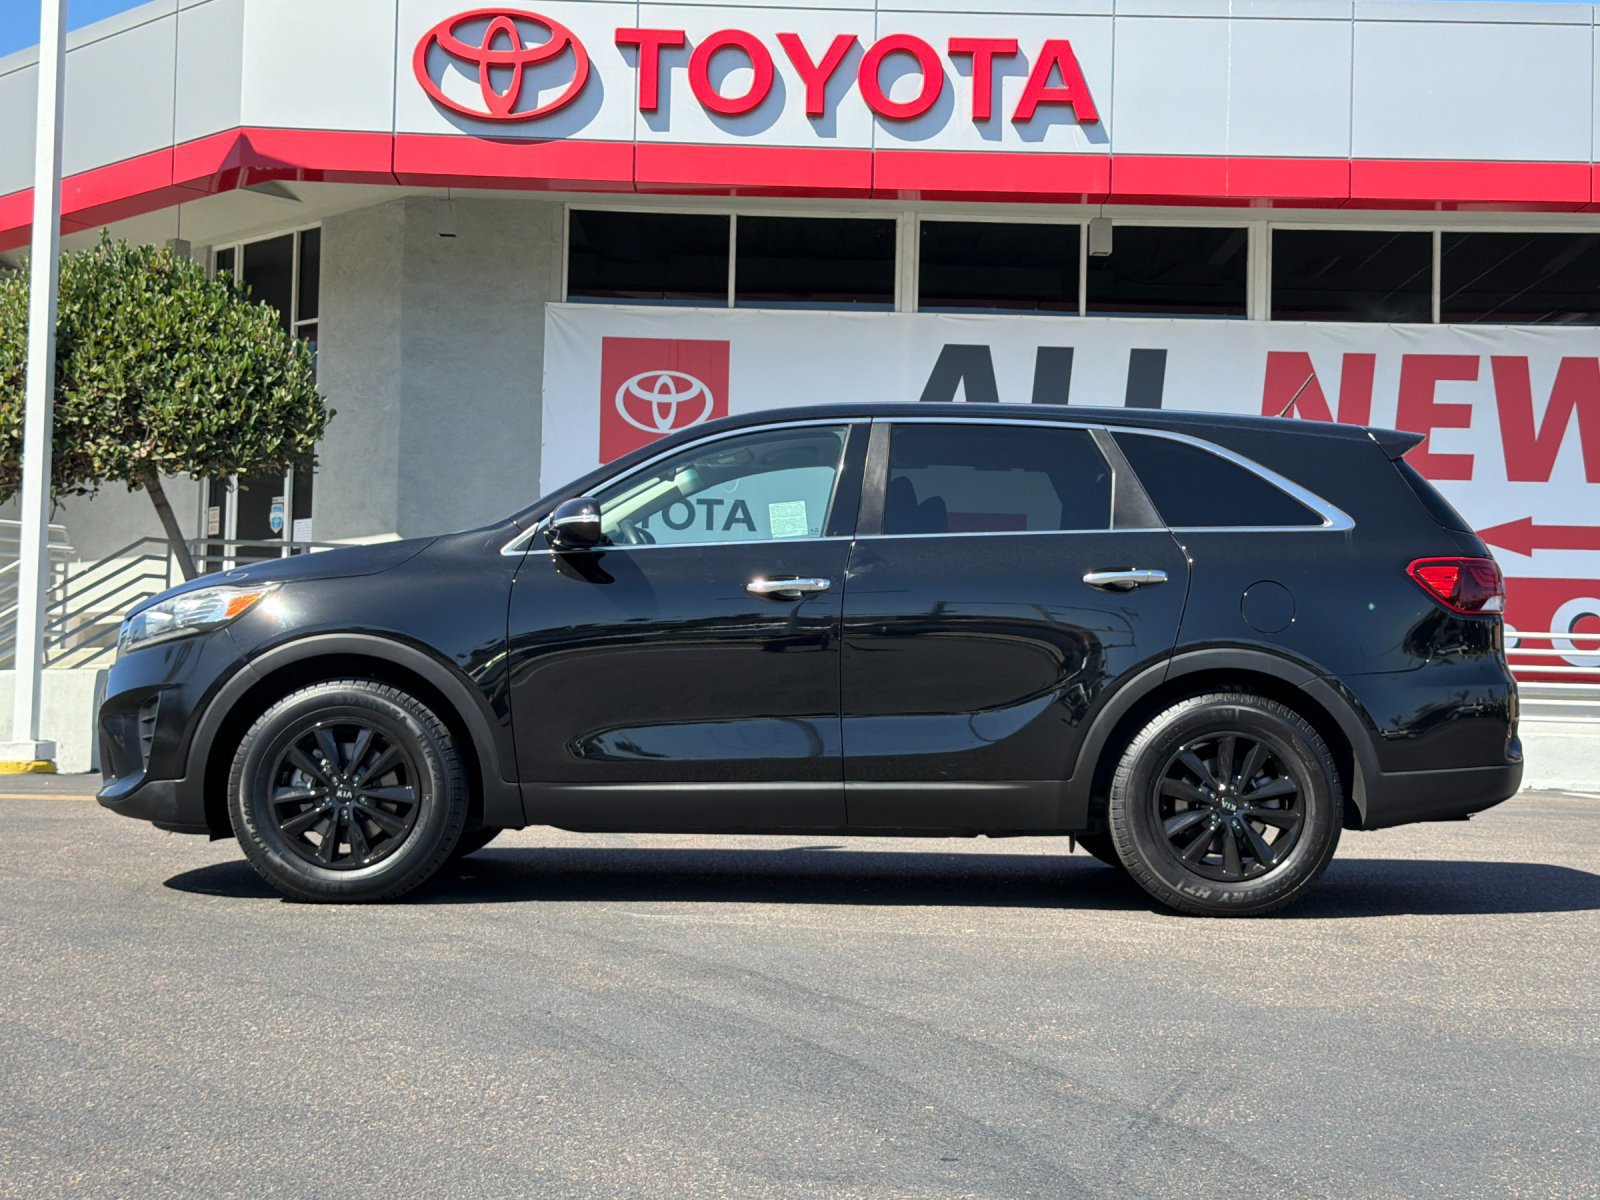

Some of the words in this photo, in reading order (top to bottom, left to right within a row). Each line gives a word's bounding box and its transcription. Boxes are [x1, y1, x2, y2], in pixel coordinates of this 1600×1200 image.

[615, 28, 1099, 122] TOYOTA
[641, 498, 757, 532] OTA
[336, 789, 354, 799] KIA
[1221, 797, 1237, 811] KIA
